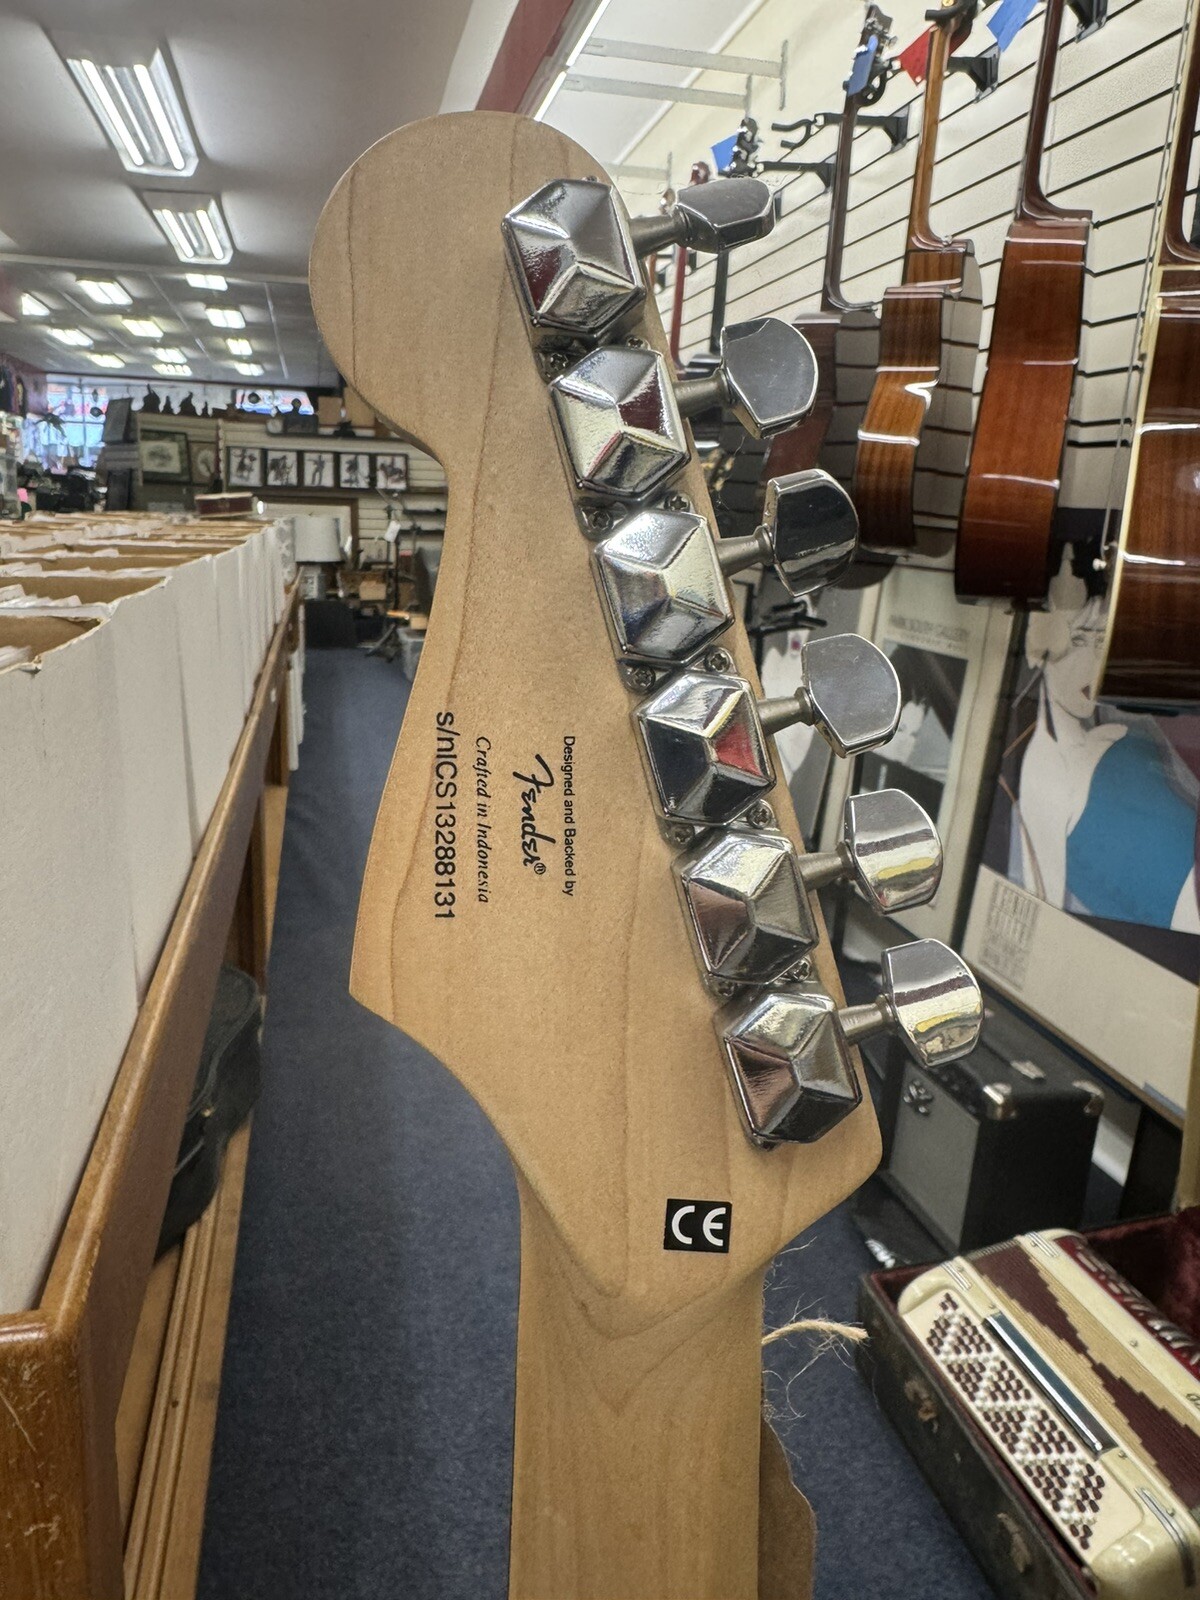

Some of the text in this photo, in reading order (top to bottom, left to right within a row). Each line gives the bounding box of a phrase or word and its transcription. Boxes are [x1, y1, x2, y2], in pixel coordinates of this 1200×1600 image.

[473, 736, 492, 903] Crafted in Indonesia
[561, 735, 577, 897] Designed and Backed by
[671, 1205, 726, 1246] CE
